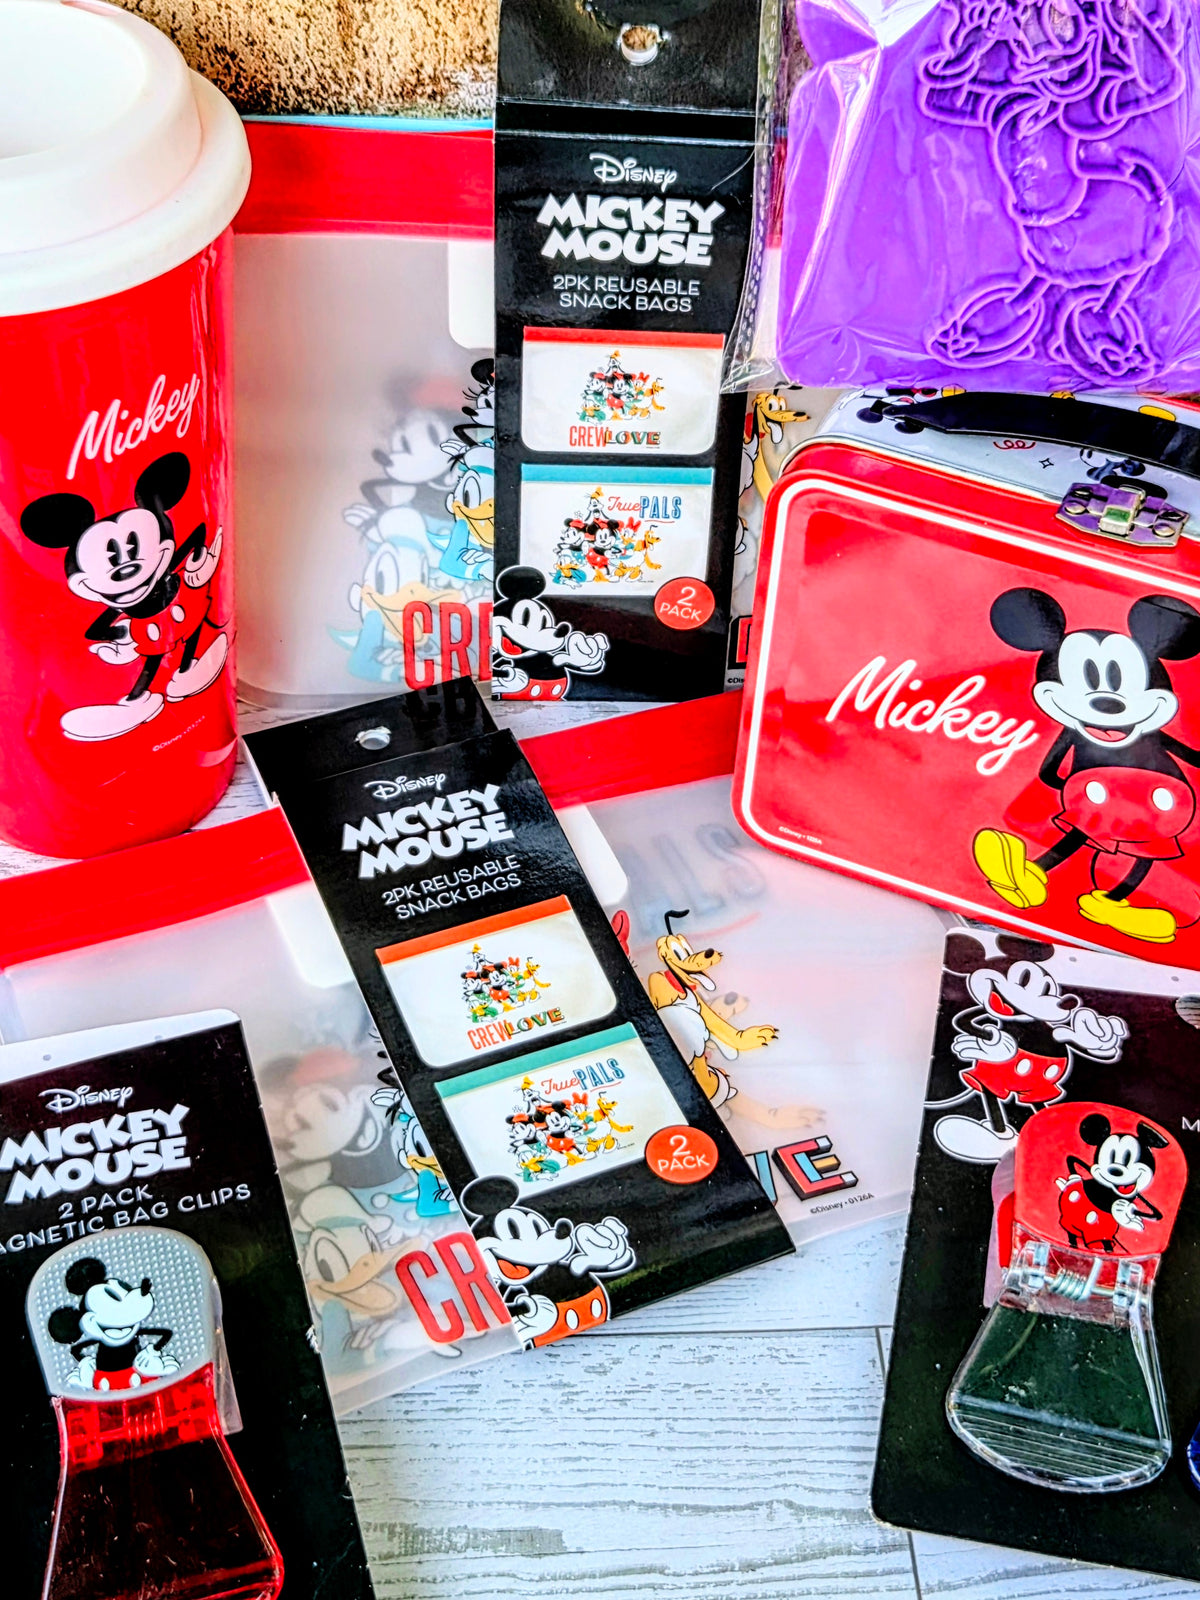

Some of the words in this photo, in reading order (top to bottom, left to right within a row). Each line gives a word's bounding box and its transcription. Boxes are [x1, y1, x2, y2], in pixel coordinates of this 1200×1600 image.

[590, 153, 677, 192] Disney
[537, 193, 726, 234] MICKEY
[541, 228, 714, 266] MOUSE
[553, 274, 591, 291] 2PK
[595, 277, 700, 296] REUSABLE
[559, 294, 631, 311] SNACK
[635, 297, 692, 312] BAGS
[66, 373, 200, 480] Mickey
[569, 425, 609, 447] CREW
[604, 430, 661, 446] LOVE
[607, 496, 642, 513] True
[639, 495, 682, 519] PALS
[659, 602, 702, 622] PACK
[677, 586, 696, 607] 2
[825, 655, 1039, 776] Mickey
[364, 773, 446, 799] Disney
[341, 783, 501, 851] MICKEY
[358, 811, 515, 879] MOUSE
[381, 883, 421, 906] 2PK
[420, 854, 521, 895] REUSABLE
[395, 888, 465, 920] SNACK
[467, 873, 522, 900] BAGS
[467, 1019, 513, 1050] CREW
[504, 1006, 565, 1037] LOVE
[540, 1076, 582, 1096] True
[572, 1058, 625, 1091] PALS
[38, 1084, 134, 1114] Disney
[0, 1103, 191, 1172] MICKEY
[669, 1134, 691, 1157] 2
[4, 1136, 192, 1206] MOUSE
[657, 1153, 710, 1173] PACK
[58, 1201, 75, 1220] 2
[81, 1183, 154, 1215] PACK
[113, 1201, 169, 1228] BAG
[177, 1182, 251, 1213] CLIPS
